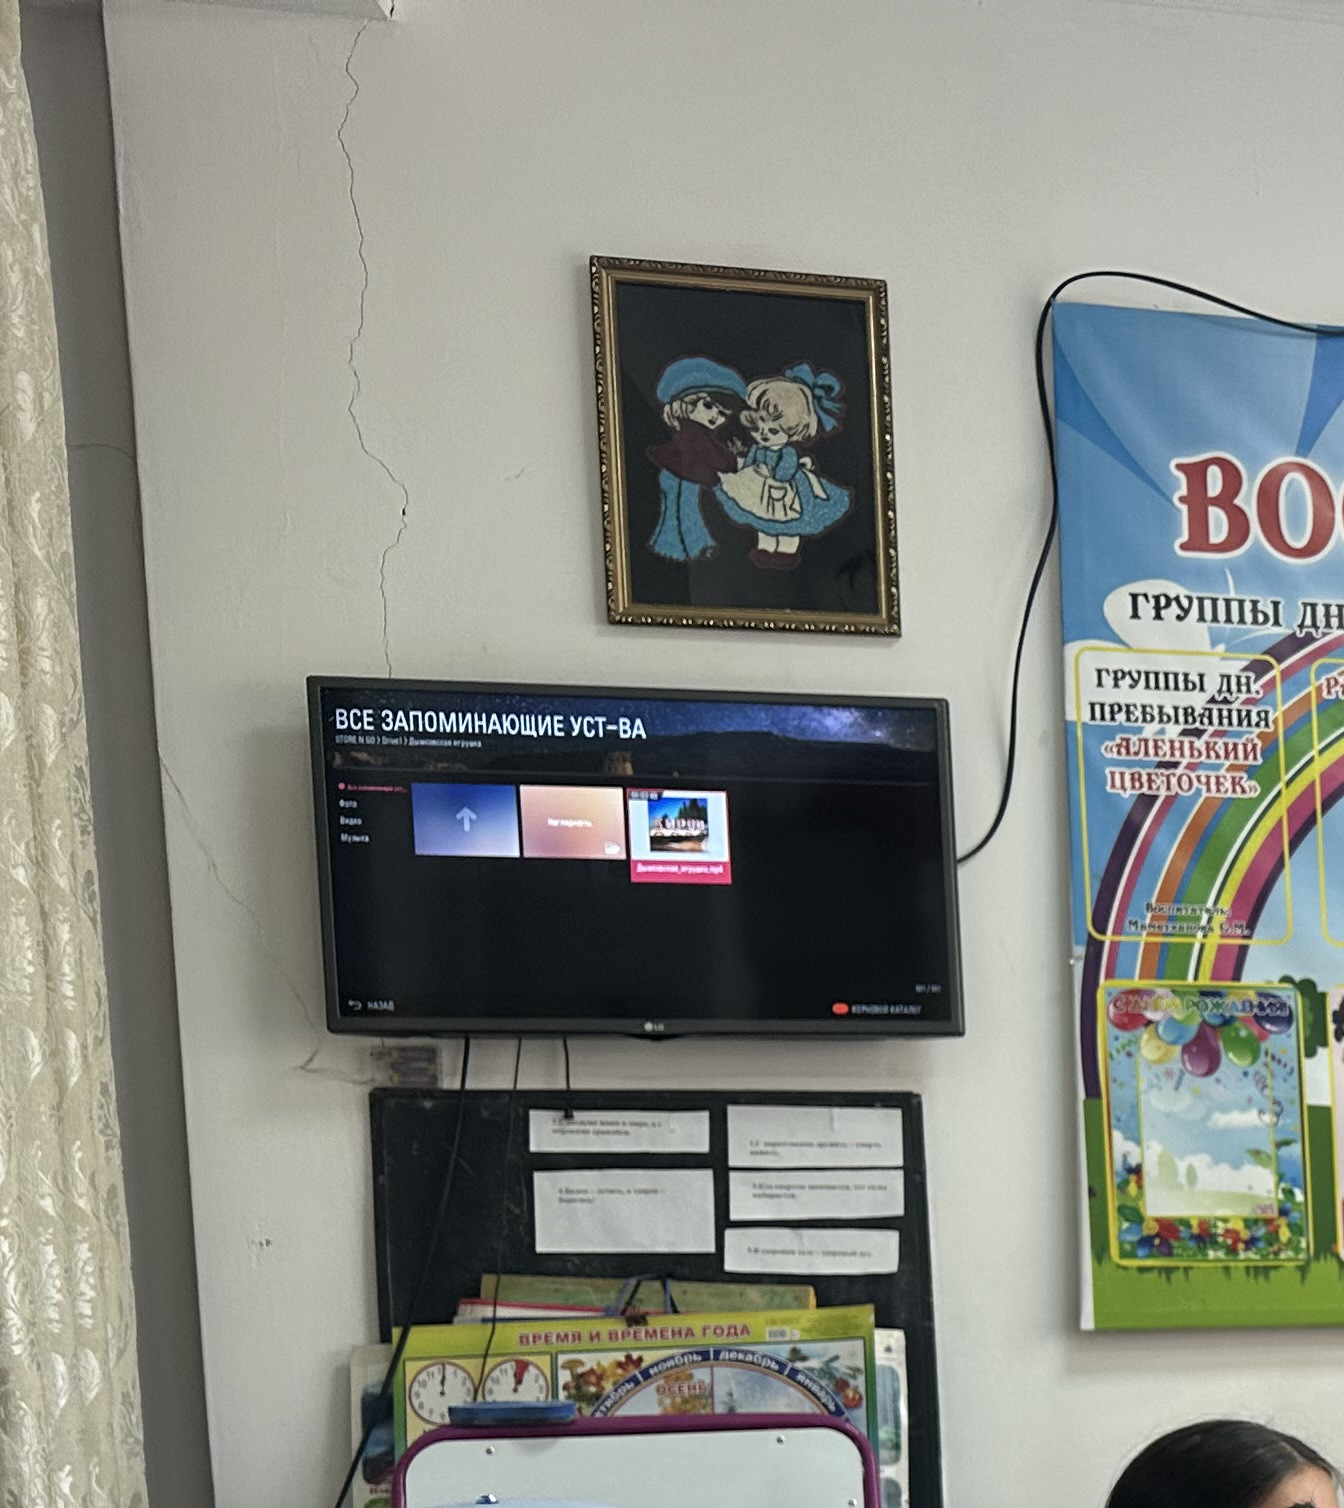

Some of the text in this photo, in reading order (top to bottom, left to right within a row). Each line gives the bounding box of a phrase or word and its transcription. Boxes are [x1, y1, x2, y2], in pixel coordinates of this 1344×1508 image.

[1128, 592, 1283, 629] ГРУППЫ
[1095, 668, 1261, 700] ГРУППЫ ДН.
[335, 708, 647, 741] ВСЕ ЗАПОМИНАЮЩИЕ УСТ-ВА
[1088, 702, 1272, 730] ПРЕБЫВАНИЯ
[1104, 736, 1261, 762] «АЛЕНЬКИЙ
[1107, 769, 1259, 797] ЦВЕТОЧЕК»
[518, 1324, 752, 1346] ВРЕМЯ И ВРЕМЕНА ГОДА
[648, 1352, 702, 1376] ноябрь
[720, 1350, 779, 1372] декабрь
[656, 1380, 707, 1397] ОСЕНЬ
